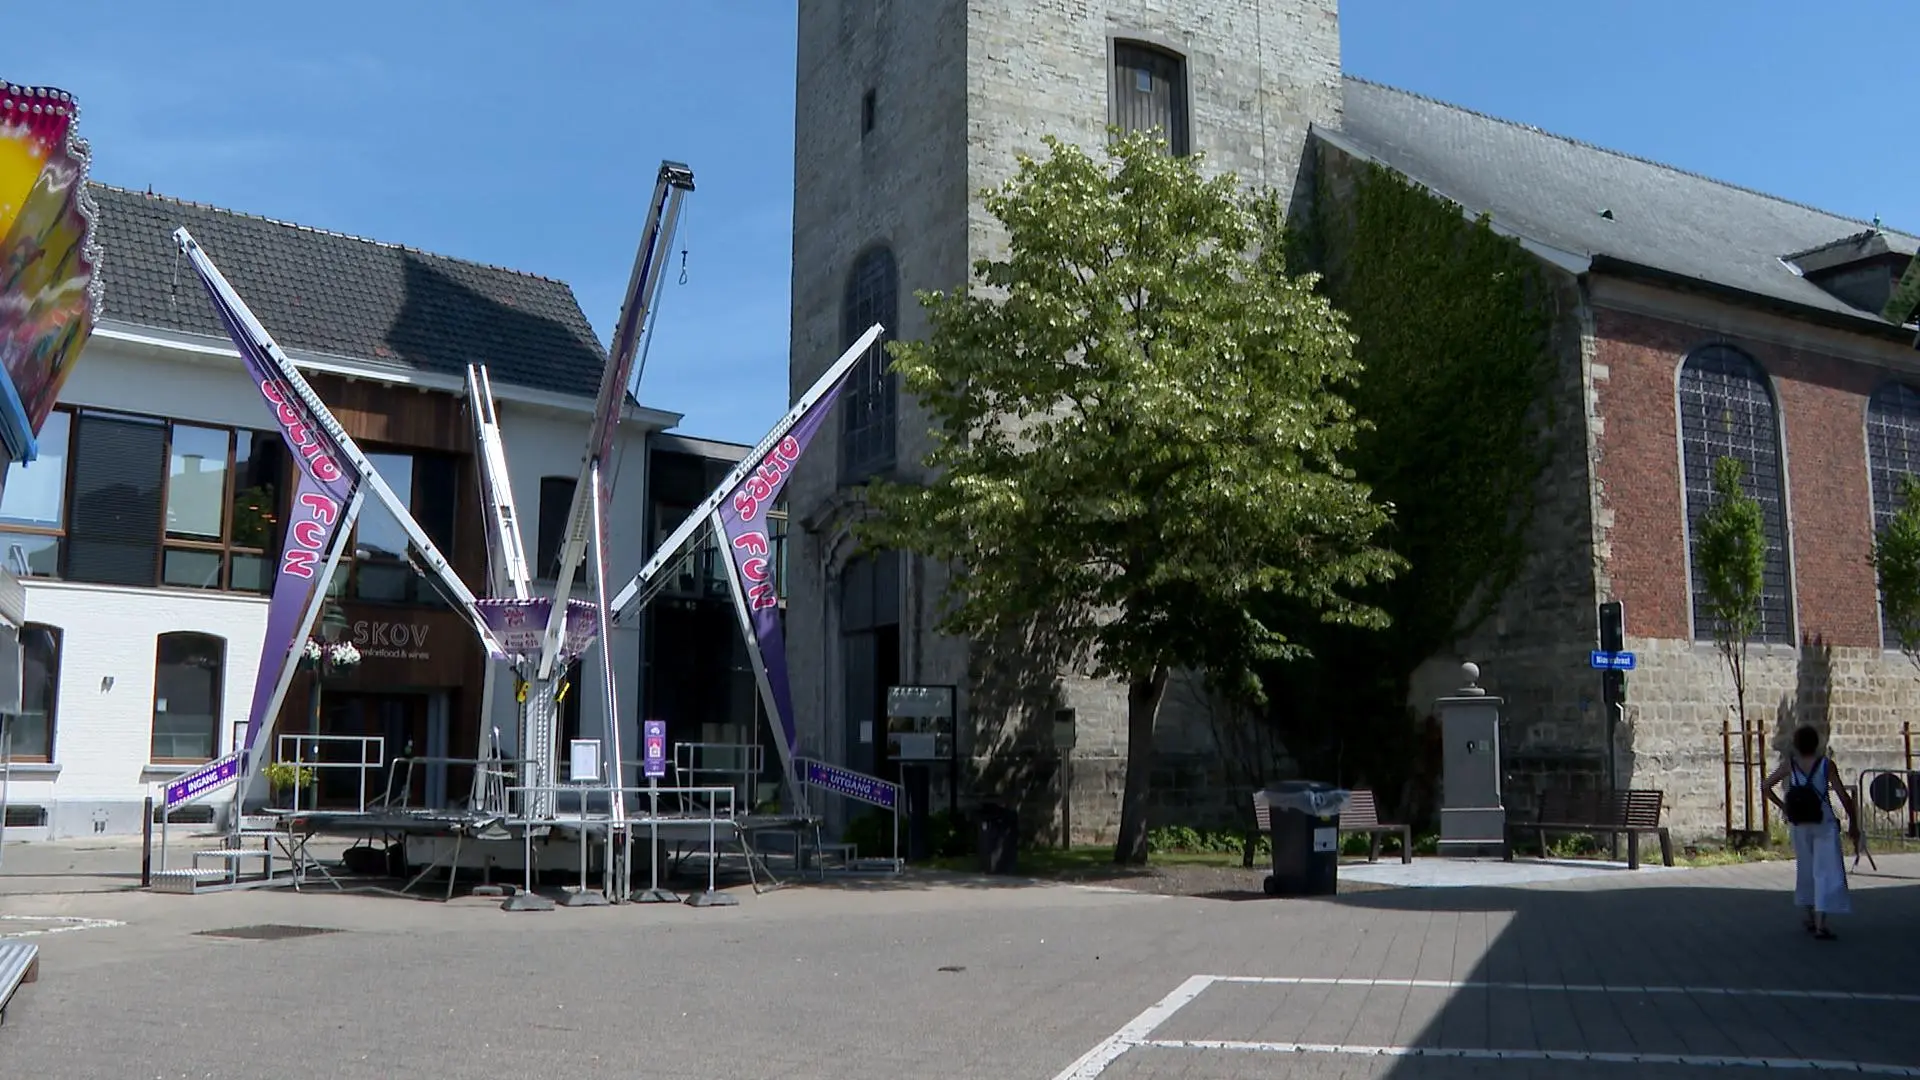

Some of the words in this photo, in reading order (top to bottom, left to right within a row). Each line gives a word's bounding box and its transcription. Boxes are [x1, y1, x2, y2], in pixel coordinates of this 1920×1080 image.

[283, 493, 338, 578] FUN
[733, 531, 777, 611] FUN
[353, 620, 429, 647] SKOV
[187, 771, 218, 793] INGANG
[830, 773, 871, 794] UITGANG
